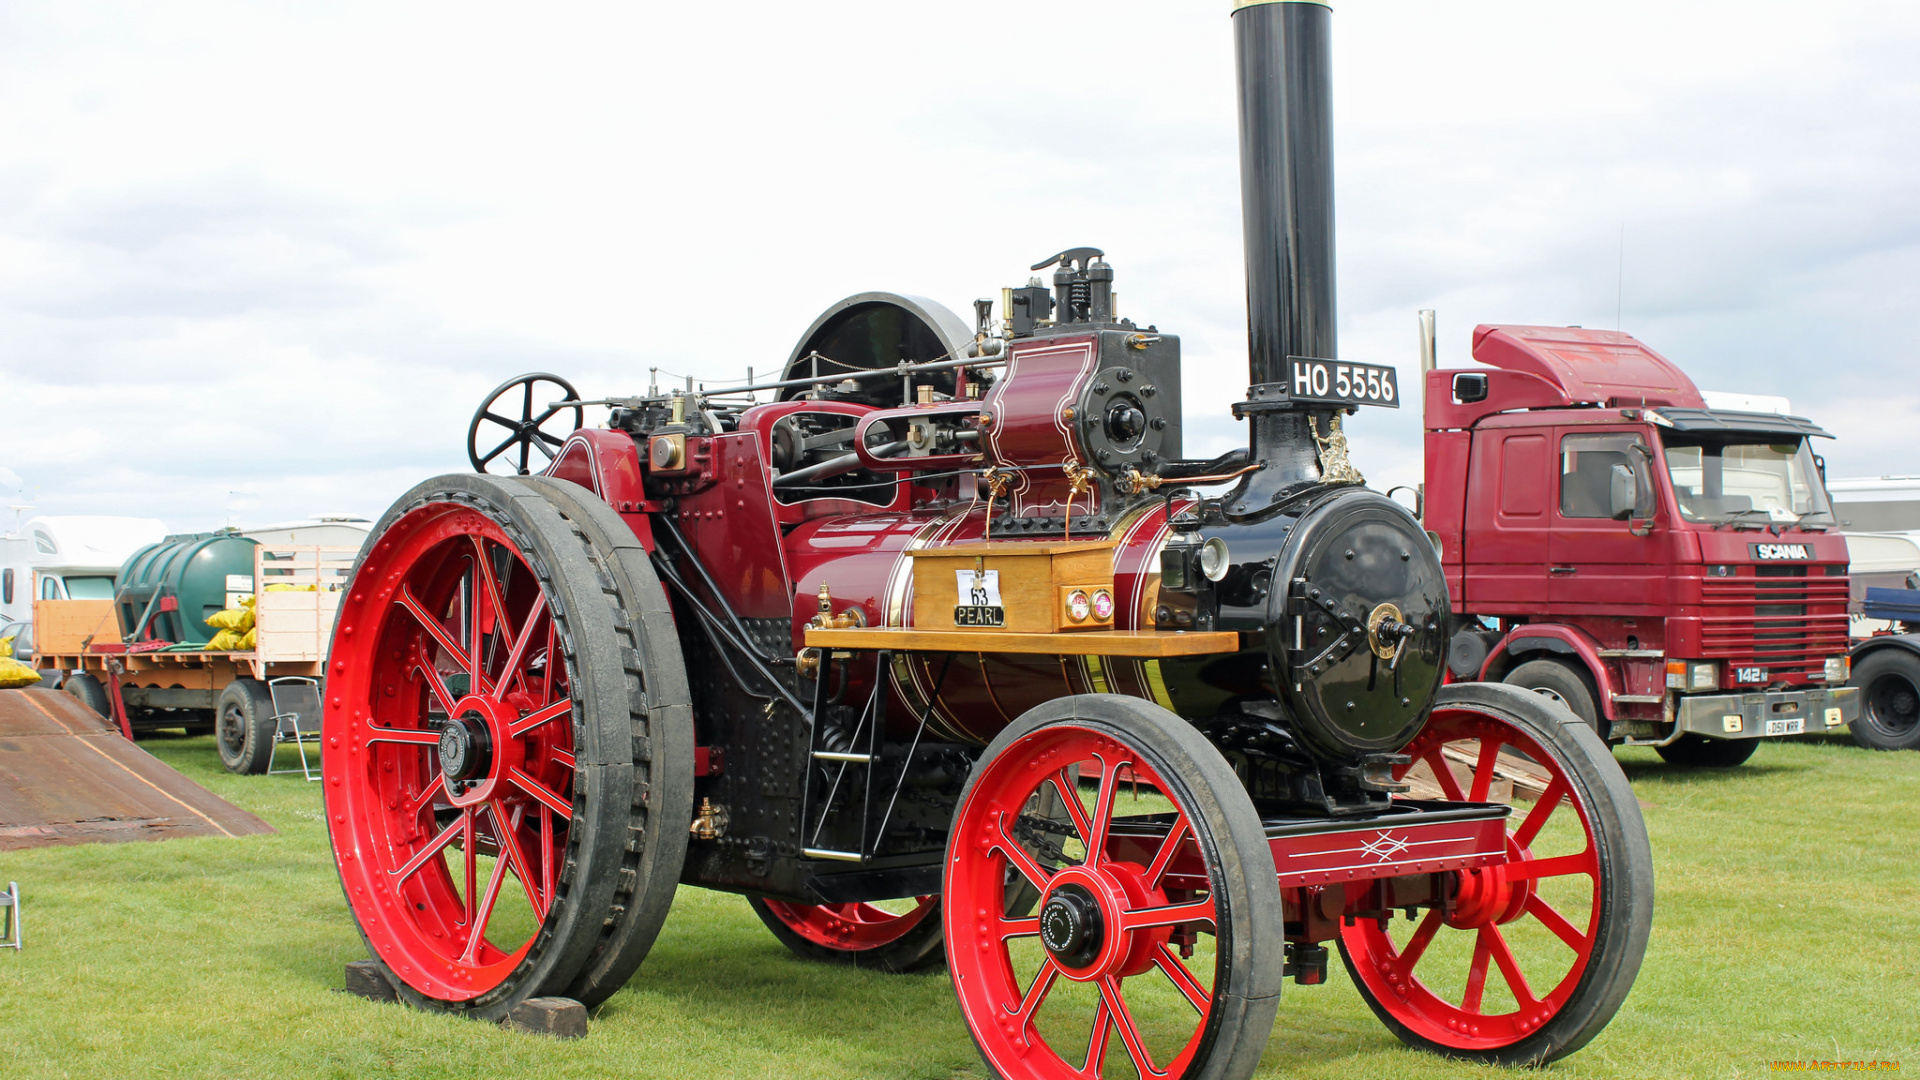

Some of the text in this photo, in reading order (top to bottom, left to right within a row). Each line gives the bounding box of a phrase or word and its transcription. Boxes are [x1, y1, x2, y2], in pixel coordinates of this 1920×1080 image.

[1294, 362, 1394, 402] HO 5556
[1758, 544, 1808, 559] SCANIA
[971, 587, 988, 605] 63
[958, 607, 1001, 624] PEARL
